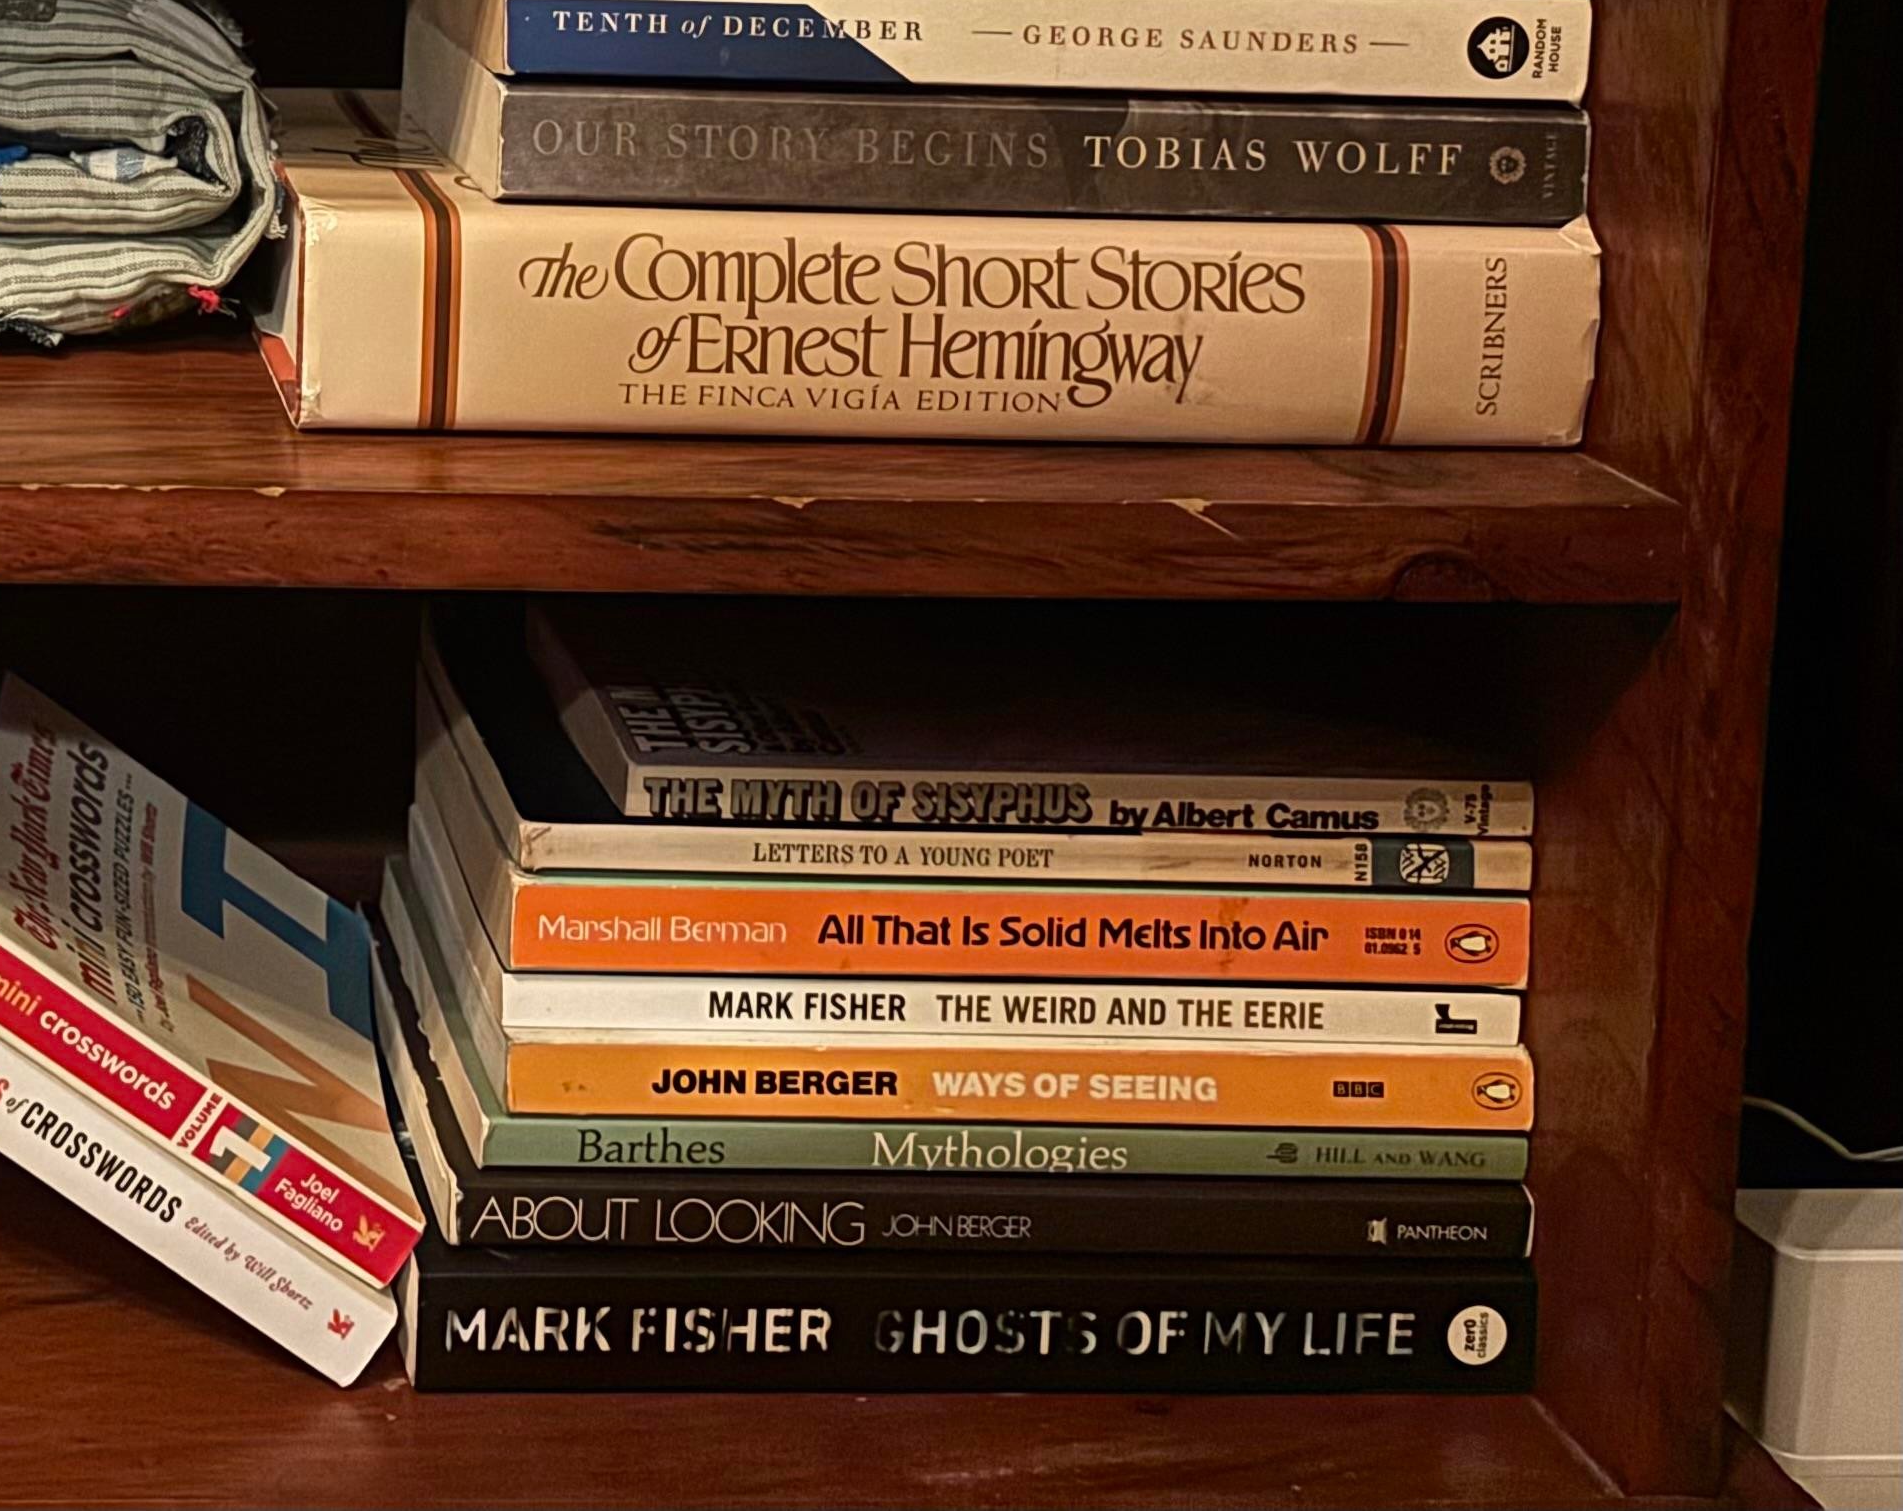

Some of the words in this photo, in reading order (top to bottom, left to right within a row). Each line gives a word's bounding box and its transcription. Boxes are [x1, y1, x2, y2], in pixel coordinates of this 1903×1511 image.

[1532, 18, 1547, 79] RANDOM
[1548, 25, 1561, 73] HOUSE
[1083, 135, 1267, 172] TOBIAS
[1292, 139, 1463, 176] WOLFF
[1475, 256, 1507, 417] SCRIBNERS
[618, 382, 687, 405] THE
[698, 386, 795, 410] FINCA
[807, 382, 901, 411] VIGÍA
[916, 388, 1060, 413] EDITION
[752, 843, 854, 865] LETTERS
[860, 845, 887, 865] TO
[894, 845, 908, 865] A
[920, 846, 990, 867] YOUNG
[998, 847, 1053, 868] POET
[1248, 854, 1323, 868] NORTON
[818, 914, 863, 945] All
[872, 915, 952, 946] That
[962, 916, 989, 946] Is
[999, 916, 1086, 948] Solid
[1099, 919, 1191, 948] Melts
[1199, 920, 1265, 950] Into
[1273, 921, 1329, 951] Air
[709, 991, 793, 1019] MARK
[804, 993, 906, 1022] FISHER
[936, 995, 991, 1022] THE
[1003, 996, 1096, 1025] WEIRD
[1107, 998, 1166, 1026] AND
[1178, 1000, 1233, 1027] THE
[1244, 1000, 1324, 1030] EERIE
[39, 1009, 176, 1111] crosswords
[651, 1068, 746, 1094] JOHN
[755, 1069, 898, 1096] BERGER
[932, 1072, 1025, 1097] WAYS
[1033, 1074, 1078, 1099] OF
[1089, 1075, 1217, 1101] SEEING
[20, 1101, 182, 1223] CROSSWORDS
[576, 1128, 725, 1163] Barthes
[274, 1178, 343, 1232] Fagliano
[300, 1172, 340, 1204] Joel
[1398, 1223, 1487, 1241] PANTHEON
